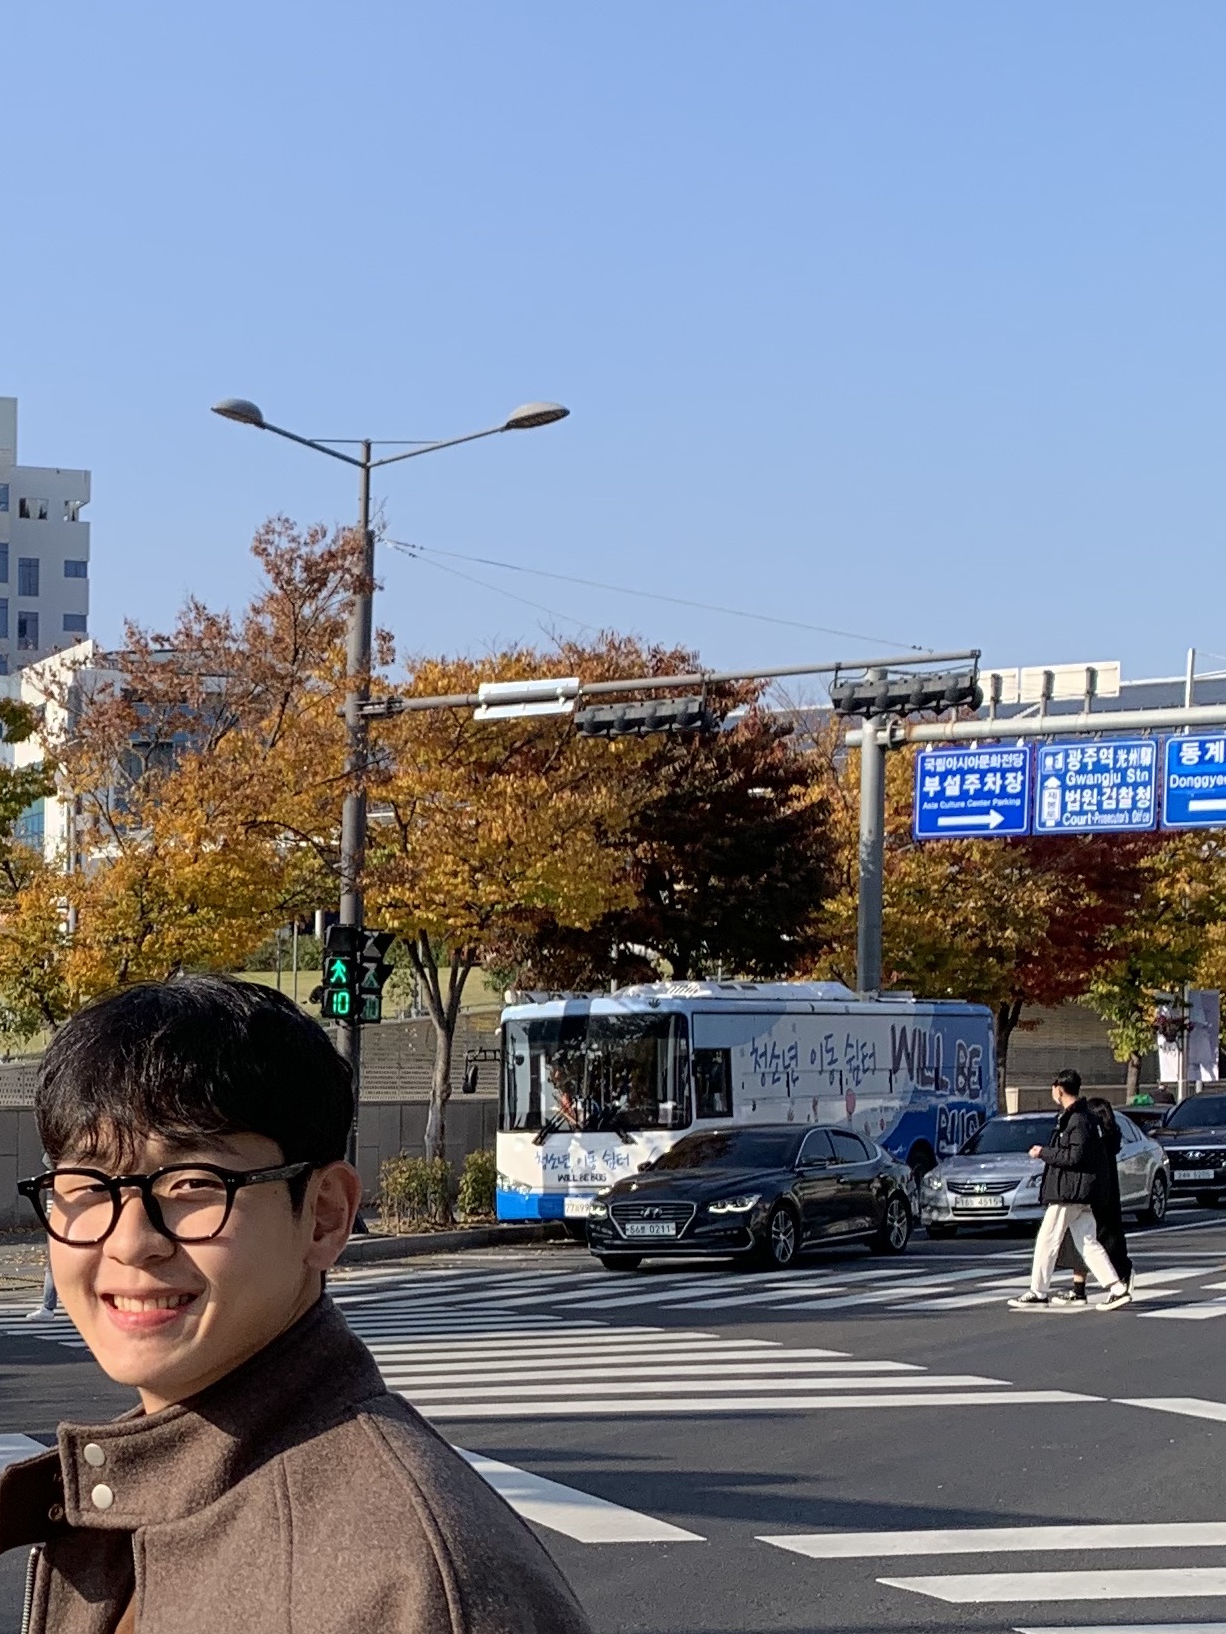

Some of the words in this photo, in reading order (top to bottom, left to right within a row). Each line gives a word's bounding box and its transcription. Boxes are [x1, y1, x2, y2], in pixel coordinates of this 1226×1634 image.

[923, 753, 1025, 772] 국립아시아문화전당
[1066, 746, 1114, 772] 광주역
[922, 771, 1024, 797] 부설주차장
[1065, 769, 1122, 787] Gwangju
[1126, 767, 1149, 784] Stn
[992, 797, 1021, 807] Parking
[333, 991, 350, 1015] 10
[750, 1035, 799, 1088] 청소년
[810, 1033, 839, 1087] 이동
[844, 1032, 877, 1088] 쉼터
[889, 1022, 951, 1095] WILL
[955, 1038, 983, 1100] BE
[535, 1150, 571, 1171] 청소년
[576, 1150, 597, 1171] 이동
[603, 1149, 630, 1170] 쉼터
[649, 1224, 671, 1234] 0211
